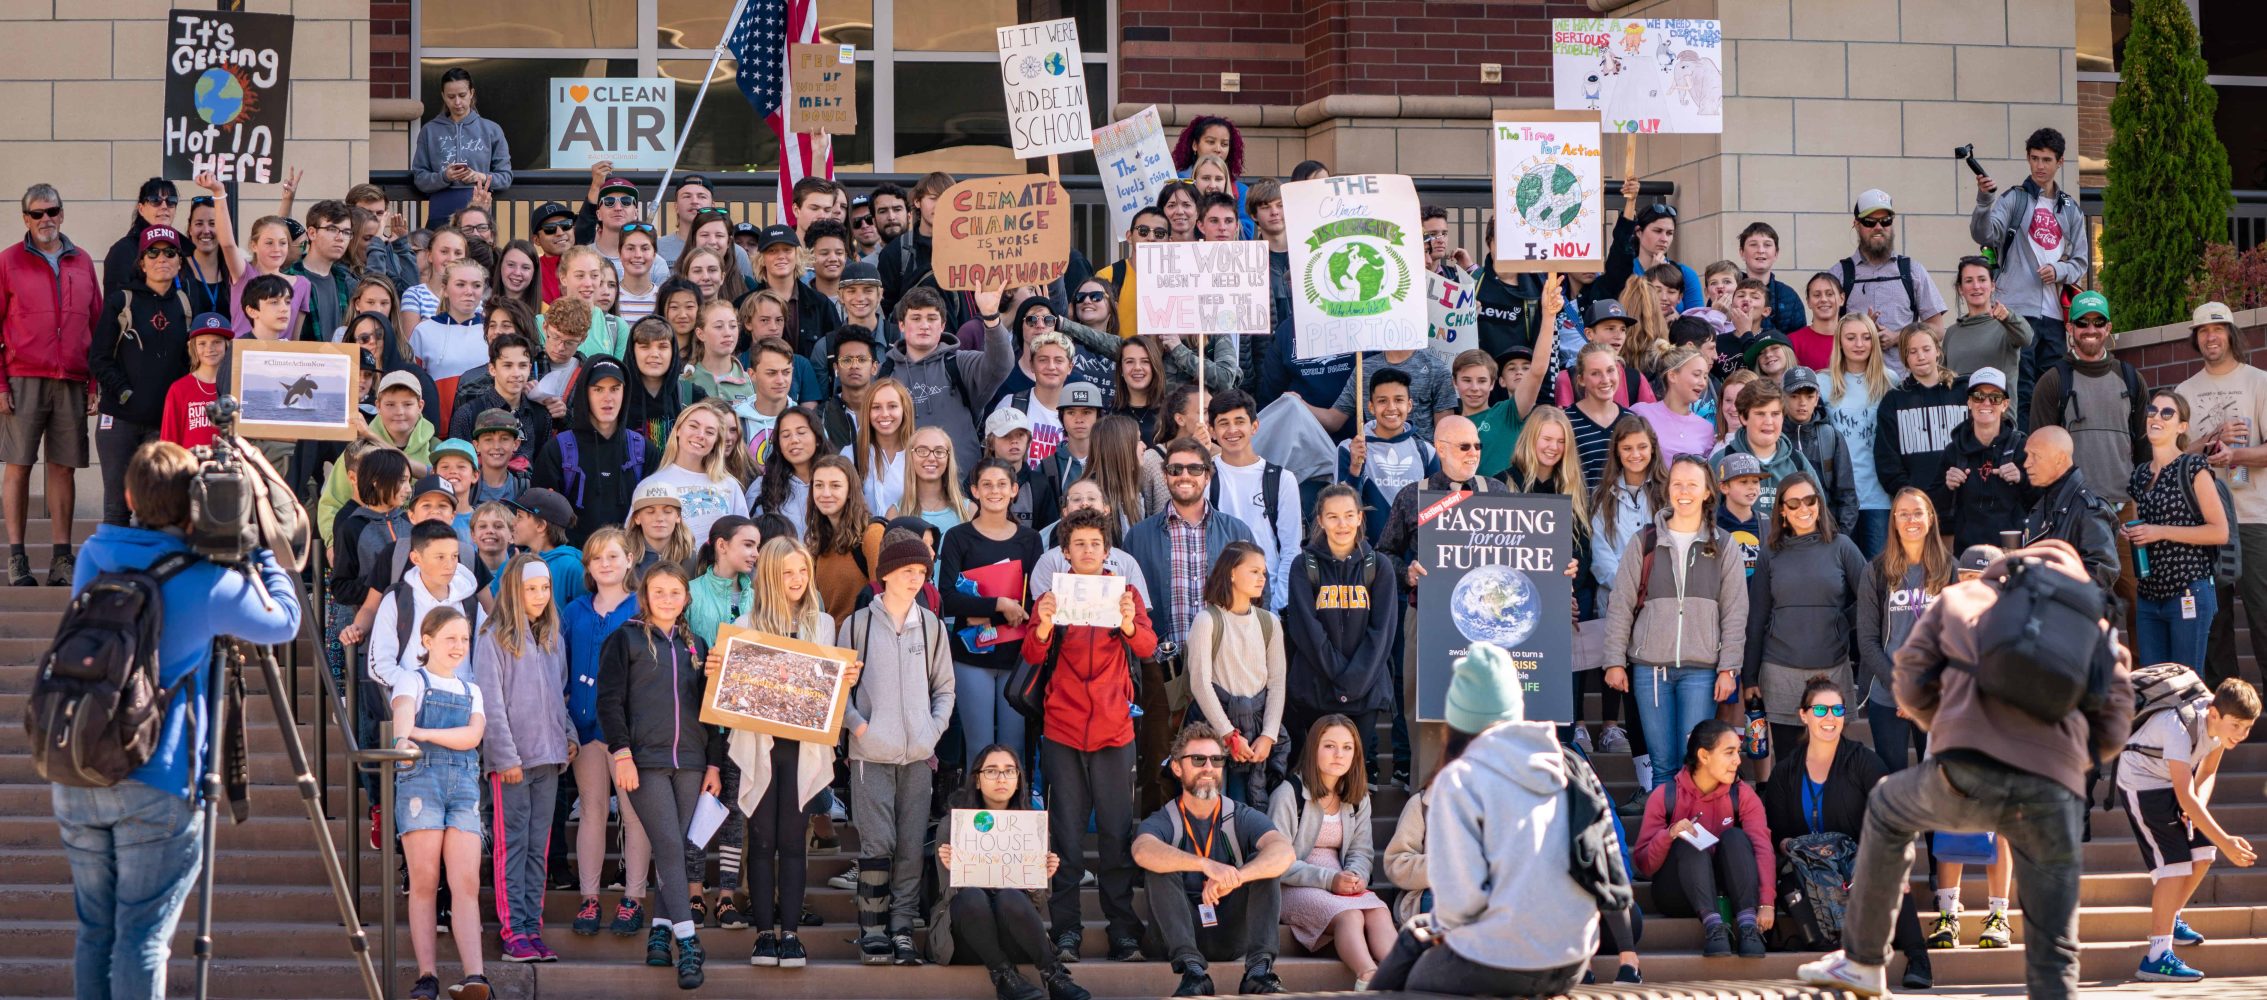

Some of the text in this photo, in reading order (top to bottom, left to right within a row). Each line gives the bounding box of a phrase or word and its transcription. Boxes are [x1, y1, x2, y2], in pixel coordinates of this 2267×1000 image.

[175, 16, 235, 50] It's
[1554, 19, 1621, 32] WE HAVE A
[1645, 18, 1714, 29] WE NEED TO
[1000, 22, 1076, 49] IF IT WERE
[1555, 31, 1611, 49] SERIOUS
[801, 54, 838, 69] FED
[823, 72, 841, 82] UP
[560, 86, 666, 103] I CLEAN
[799, 96, 842, 108] MELT
[1042, 87, 1061, 110] BE
[1065, 84, 1083, 106] IN
[801, 111, 846, 122] DOWN
[166, 116, 220, 156] Hot
[558, 106, 666, 151] AIR
[1015, 111, 1090, 150] SCHOOL
[1499, 127, 1555, 142] The Time
[1541, 141, 1600, 156] for Action
[1110, 157, 1137, 178] The
[1324, 175, 1379, 196] THE
[953, 181, 1058, 212] CLIMATE
[1122, 196, 1138, 212] and
[1318, 196, 1370, 219] Climate
[147, 228, 175, 241] RENO
[950, 210, 1050, 240] CHANGE
[977, 234, 1039, 249] IS WORSE
[2034, 227, 2058, 245] Coca-Cola
[988, 246, 1022, 260] THAN
[1139, 241, 1268, 274] THE WORLD
[1525, 242, 1591, 261] Is NOW
[949, 261, 1067, 288] HOMEWORK
[1157, 272, 1265, 289] DOESN'T NEED US
[1142, 293, 1252, 329] WE NEED THE
[1306, 318, 1423, 353] PERIOD.
[264, 359, 326, 369] #ClimateActionNow
[1301, 362, 1351, 376] WOLF PACK
[1032, 423, 1066, 444] NIK
[1375, 475, 1415, 488] adidas
[1420, 491, 1463, 521] Fasting today!
[1435, 508, 1556, 534] FASTING
[1465, 528, 1525, 549] for our
[1436, 544, 1554, 571] FUTURE
[1513, 660, 1538, 671] RISIS
[965, 833, 1035, 852] HOUSE
[978, 852, 1024, 865] IS ON
[963, 864, 1038, 886] FIRE
